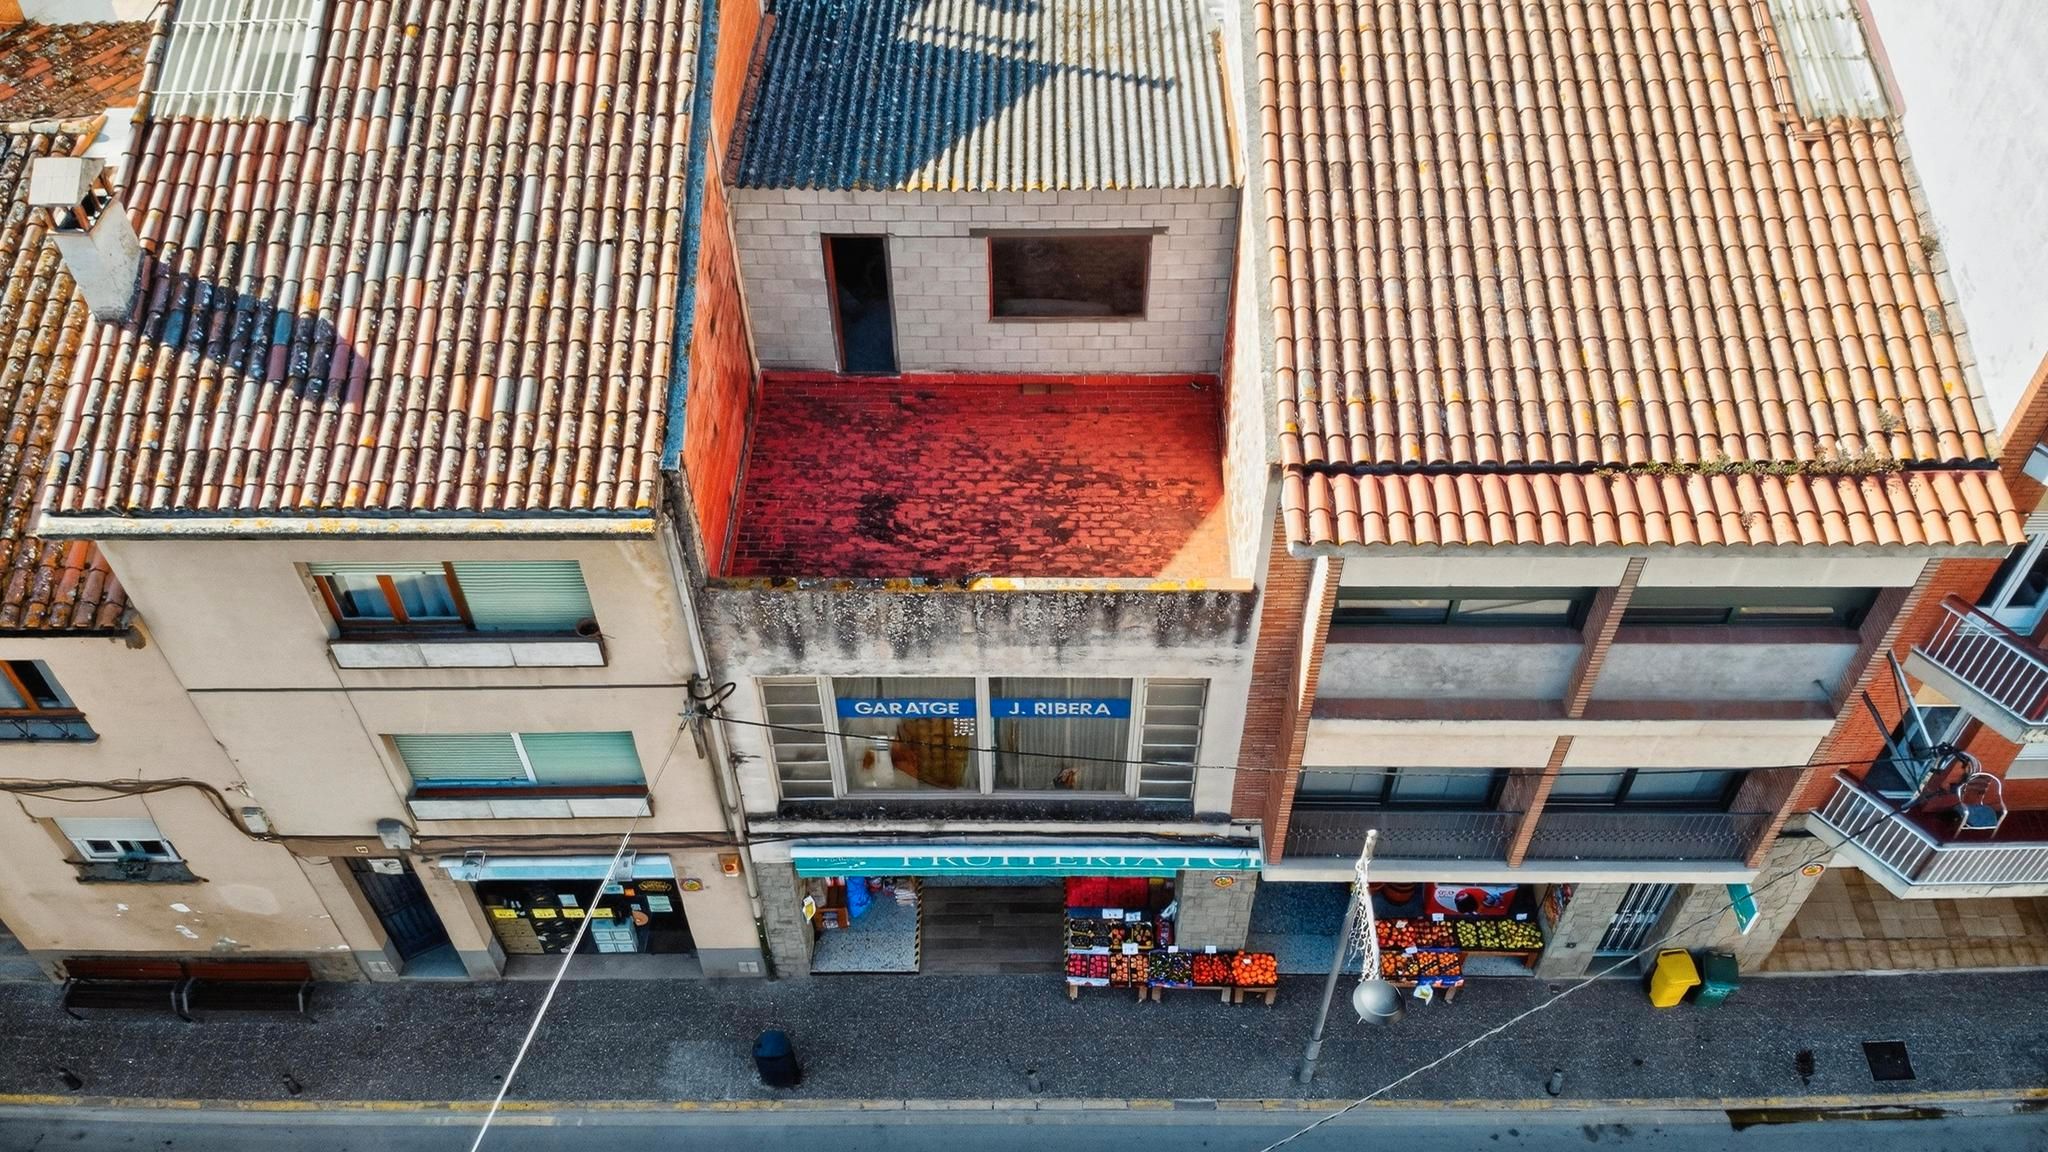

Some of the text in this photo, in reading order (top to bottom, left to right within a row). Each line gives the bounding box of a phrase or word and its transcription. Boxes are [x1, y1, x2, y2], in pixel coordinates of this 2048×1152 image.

[854, 702, 1111, 715] GARATGE J. RIBERA
